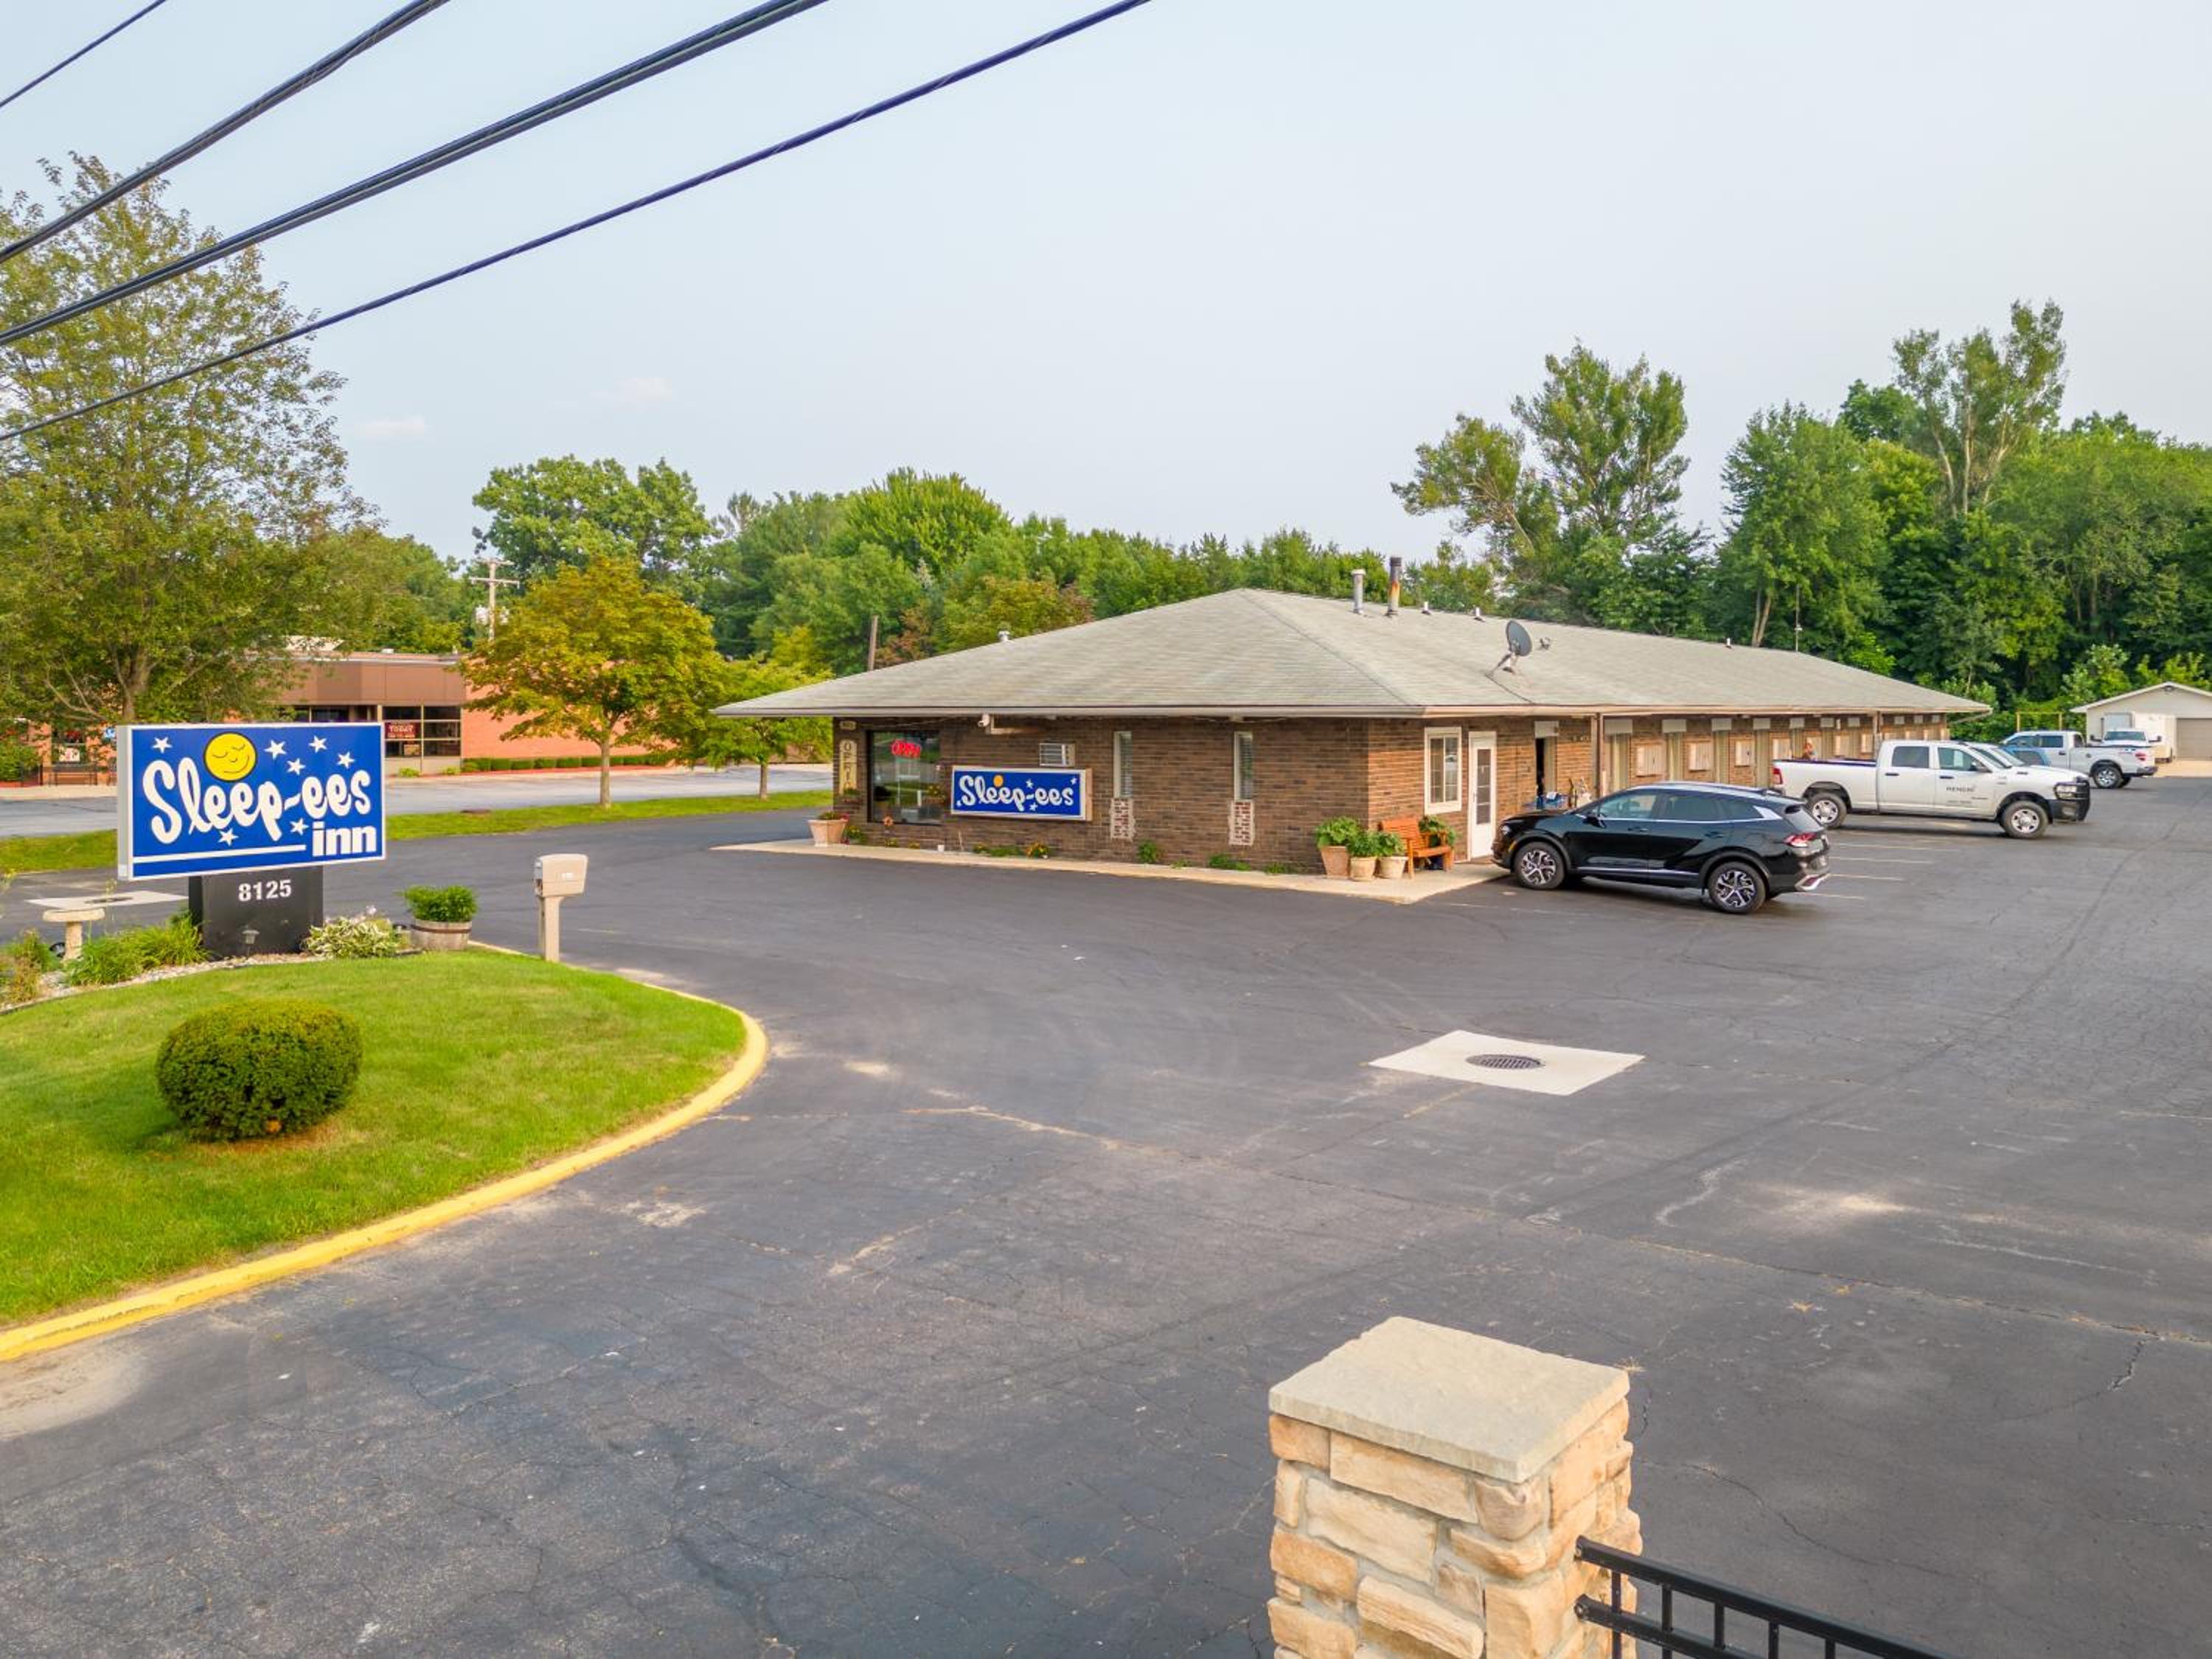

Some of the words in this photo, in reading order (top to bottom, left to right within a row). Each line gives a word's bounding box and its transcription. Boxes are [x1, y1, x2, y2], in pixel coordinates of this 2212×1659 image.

[142, 757, 371, 844] Sleep-ees
[959, 775, 1074, 811] Sleep-ees
[312, 821, 377, 857] inn
[238, 880, 291, 902] 8125
